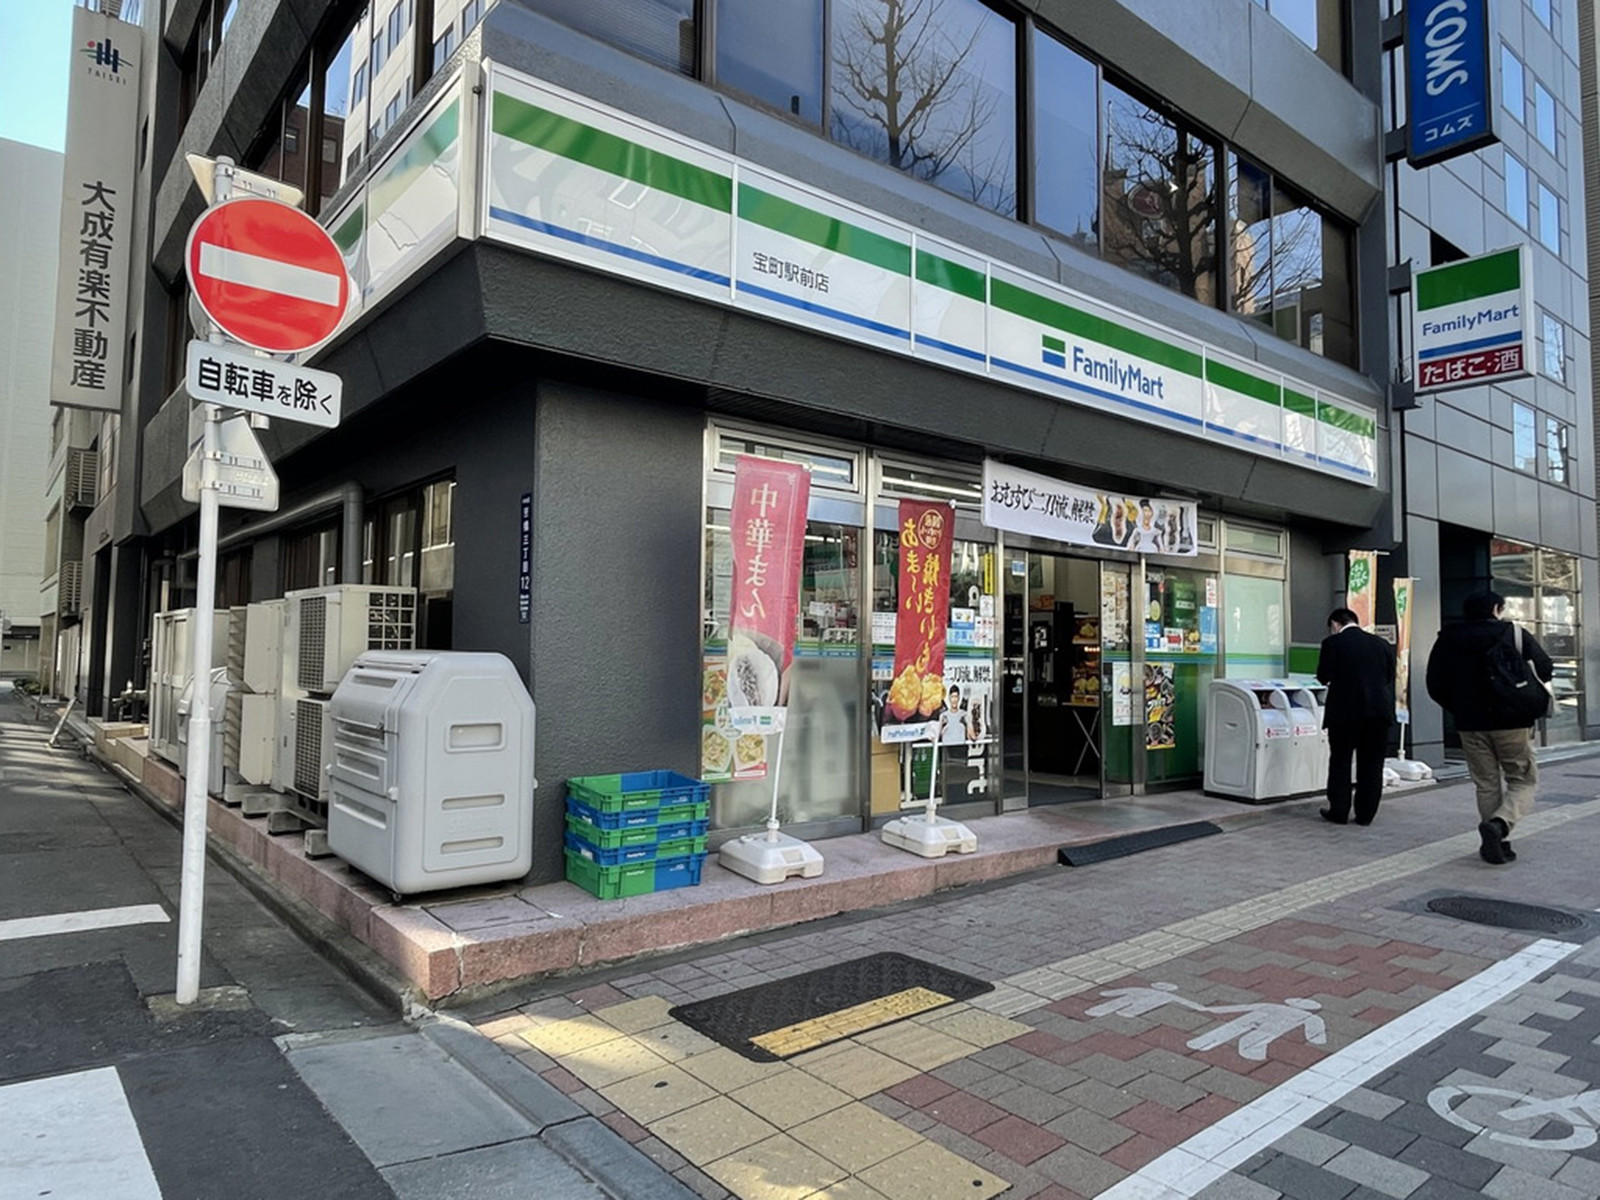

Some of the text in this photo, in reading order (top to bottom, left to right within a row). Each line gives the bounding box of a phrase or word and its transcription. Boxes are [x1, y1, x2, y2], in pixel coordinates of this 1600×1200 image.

[1424, 0, 1469, 96] COMS
[87, 67, 126, 85] TAISEI
[1424, 114, 1474, 142] コムス
[70, 181, 117, 390] 大成有楽不動産
[752, 251, 830, 293] 宝町駅前店
[1422, 304, 1519, 336] FamilyMart
[199, 357, 333, 415] 自転車を除く
[1073, 345, 1164, 399] FamilyMart
